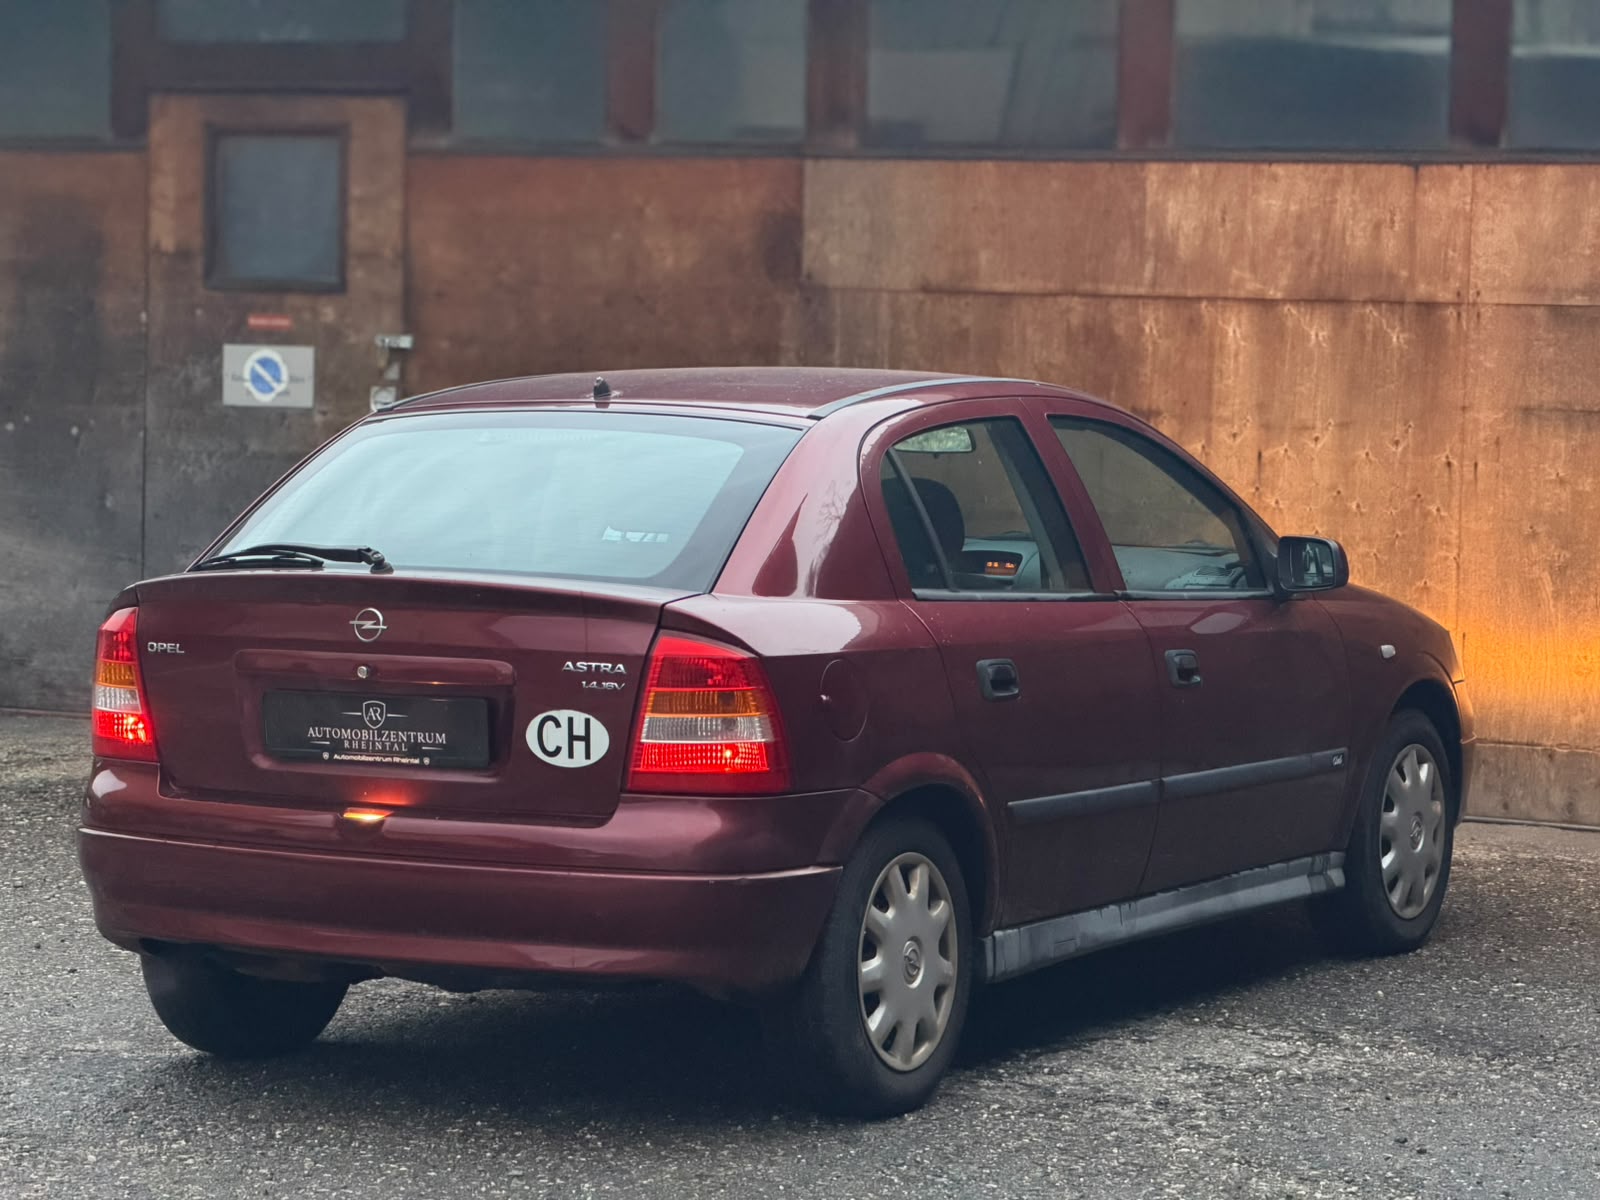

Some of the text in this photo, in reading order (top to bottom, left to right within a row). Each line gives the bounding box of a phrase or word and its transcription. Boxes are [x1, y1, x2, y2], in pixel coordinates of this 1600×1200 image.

[147, 642, 185, 654] OPEL
[562, 661, 626, 673] ASTRA
[367, 707, 382, 721] AR
[307, 727, 446, 744] AUTOMOBILZENTRUM
[537, 715, 590, 760] CH
[344, 741, 408, 751] RHEINTAL
[333, 754, 392, 763] Automobilzentrum
